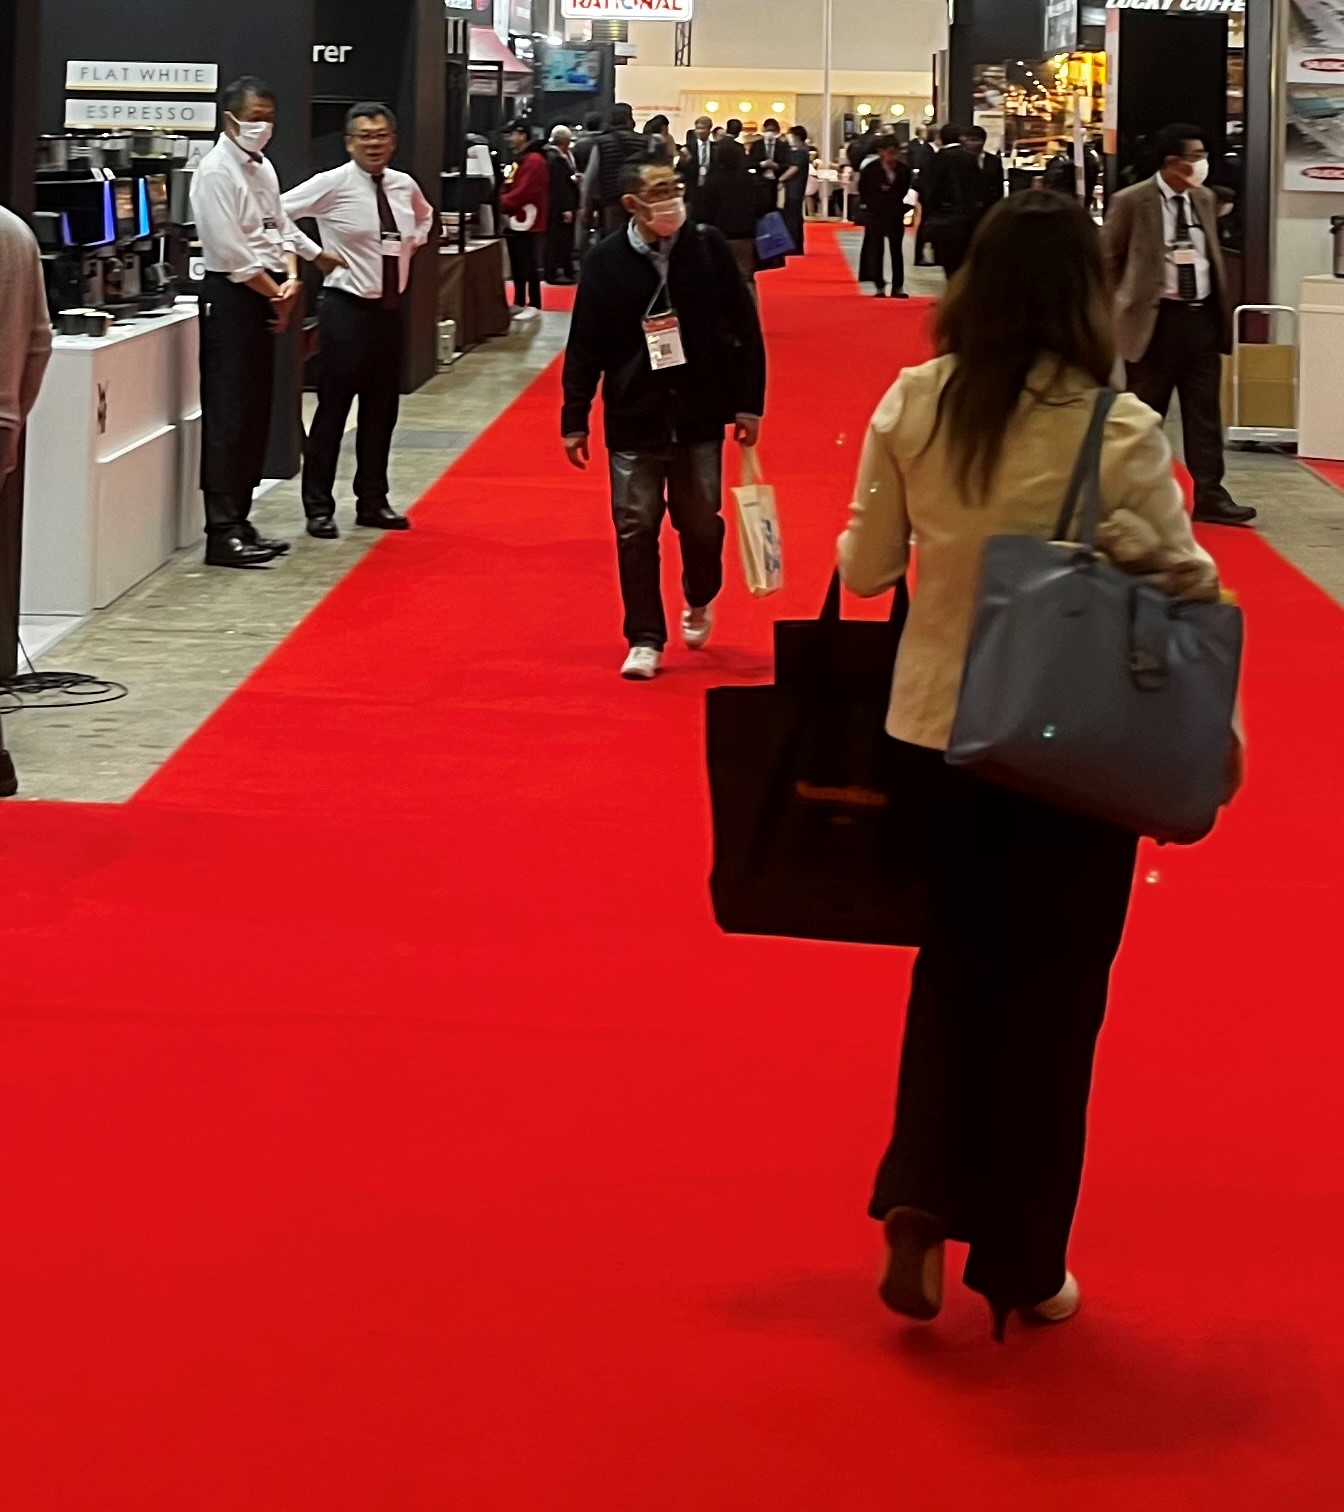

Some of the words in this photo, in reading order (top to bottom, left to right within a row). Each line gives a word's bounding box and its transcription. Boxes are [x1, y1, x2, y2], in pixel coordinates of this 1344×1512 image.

[312, 44, 353, 64] rer
[80, 66, 129, 81] FLAT
[140, 67, 205, 83] WHITE
[86, 105, 195, 121] ESPRESSO
